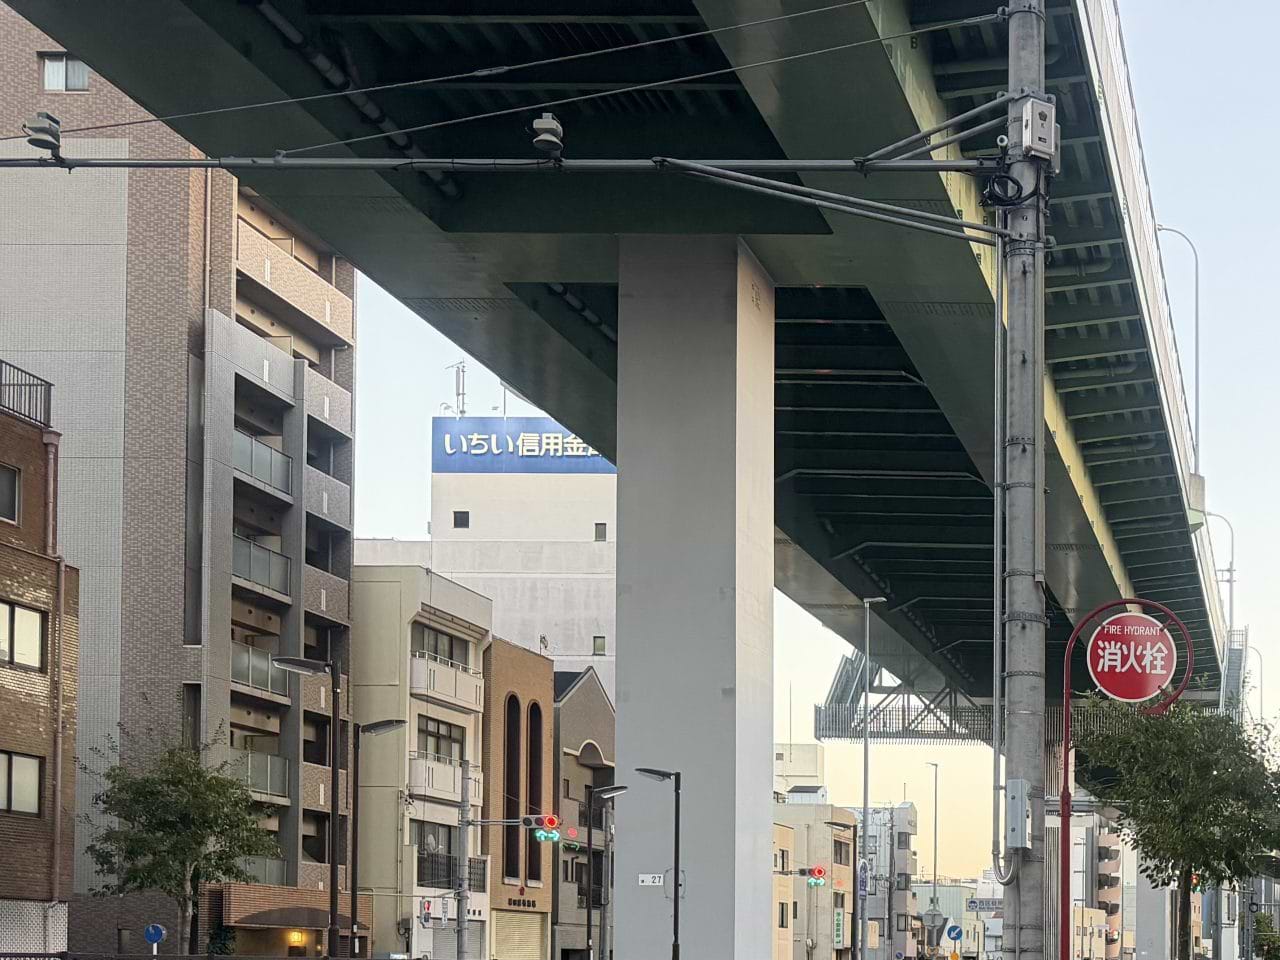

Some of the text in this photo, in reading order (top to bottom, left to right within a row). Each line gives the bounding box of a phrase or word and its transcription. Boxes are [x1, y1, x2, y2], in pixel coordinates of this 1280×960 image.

[1104, 625, 1161, 636] FIRE HYDRANT
[1097, 640, 1168, 674] 消火栓
